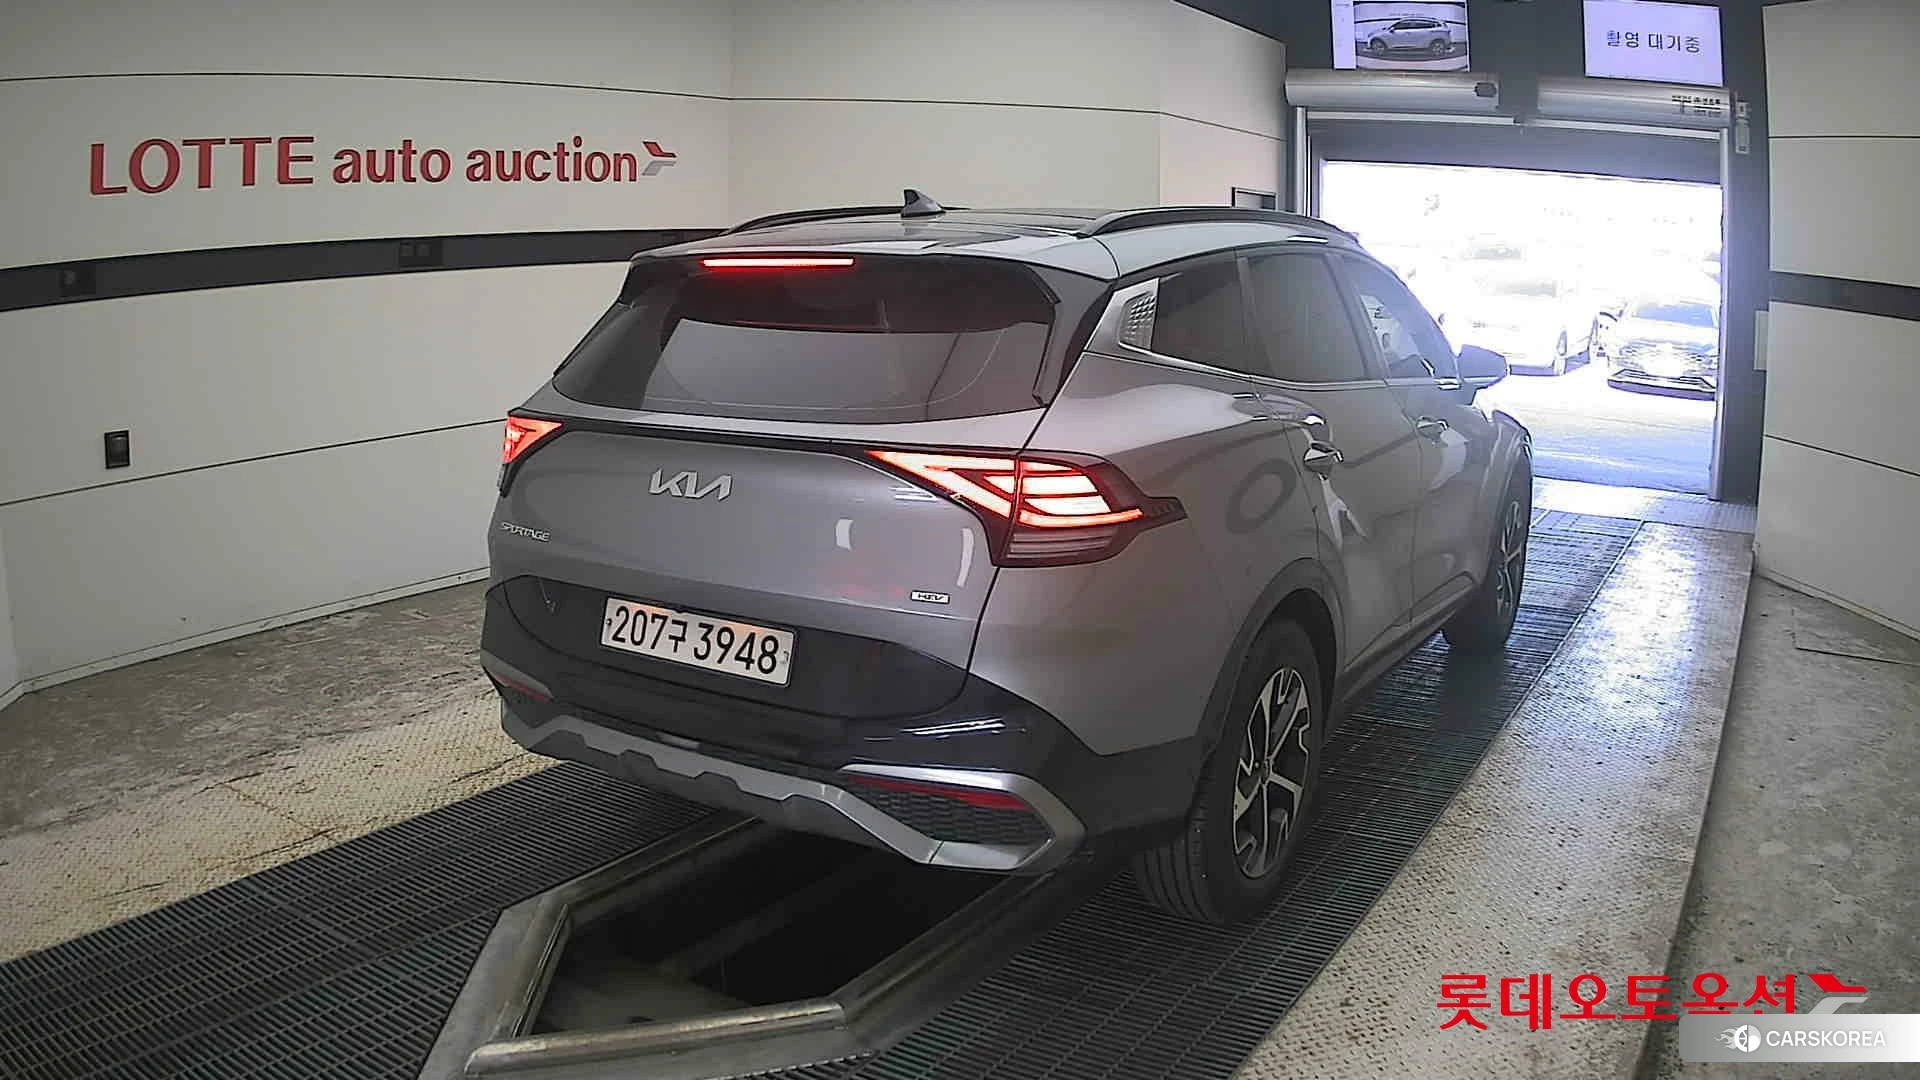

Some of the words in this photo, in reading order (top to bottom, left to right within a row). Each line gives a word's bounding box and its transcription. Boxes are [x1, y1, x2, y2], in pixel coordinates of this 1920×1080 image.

[1648, 32, 1701, 54] 대기중
[90, 136, 315, 197] LOTTE
[332, 138, 452, 184] auto
[465, 135, 638, 183] auction
[648, 468, 733, 501] KIA
[612, 605, 688, 653] 207구
[693, 622, 779, 675] 3948
